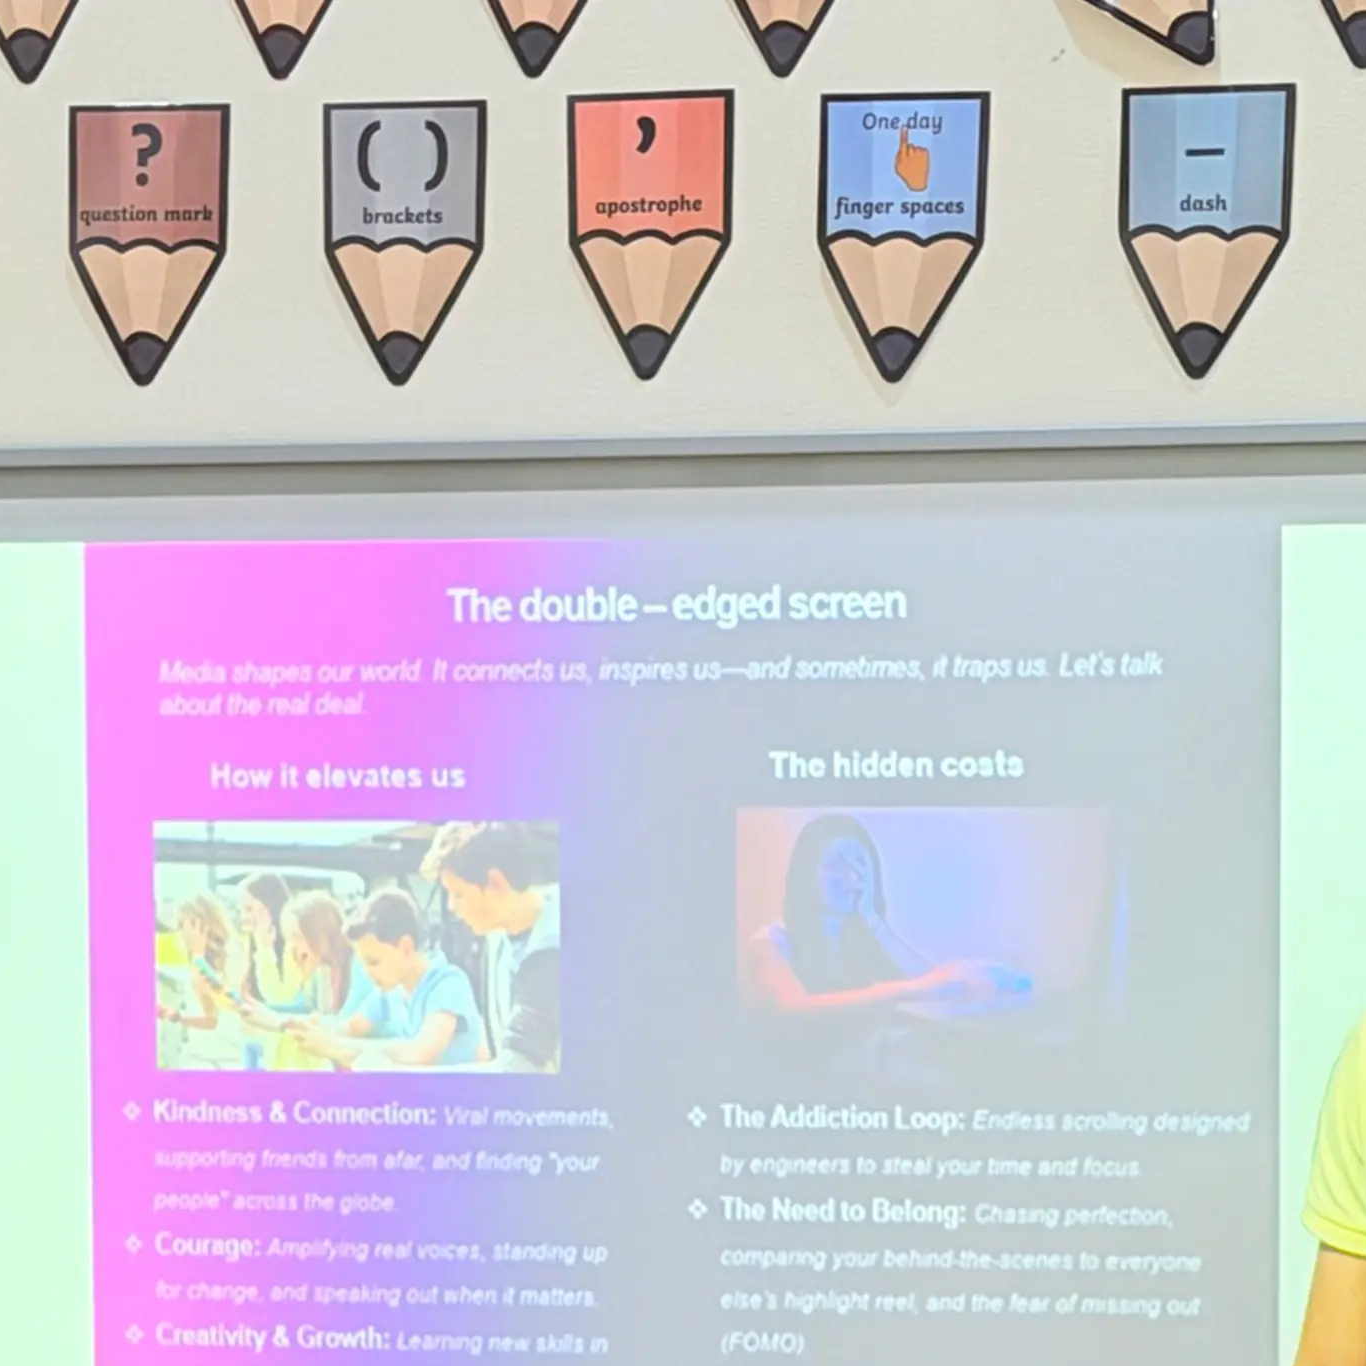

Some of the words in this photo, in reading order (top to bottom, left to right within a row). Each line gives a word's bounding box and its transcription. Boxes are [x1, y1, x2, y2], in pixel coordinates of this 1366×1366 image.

[861, 112, 901, 132] One
[905, 111, 943, 135] day
[131, 122, 164, 187] ?
[79, 204, 158, 226] question
[164, 205, 214, 222] mark
[362, 206, 443, 227] brackets
[594, 194, 703, 219] apostrophe
[834, 196, 893, 219] finger
[899, 198, 965, 219] spaces
[1178, 193, 1228, 214] dash
[446, 587, 512, 622] The
[519, 586, 638, 622] double
[672, 584, 781, 629] edged
[789, 591, 907, 619] screen
[159, 659, 226, 683] Media
[232, 661, 312, 687] shapes
[317, 665, 354, 682] our
[453, 658, 554, 681] connects
[560, 662, 591, 683] us,
[599, 662, 688, 686] inspires
[933, 654, 948, 678] it
[953, 655, 1011, 684] traps
[1121, 651, 1164, 676] talk
[159, 694, 222, 716] about
[227, 693, 262, 716] the
[267, 692, 310, 715] real
[210, 762, 273, 788] How
[281, 763, 298, 787] it
[306, 763, 422, 788] elevates
[432, 768, 465, 788] us
[768, 751, 826, 779] The
[834, 750, 933, 778] hidden
[941, 749, 1024, 777] costs
[153, 1098, 262, 1123] Kindness
[269, 1100, 287, 1123] &
[293, 1101, 436, 1125] Connection:
[445, 1107, 489, 1125] Viral
[494, 1108, 613, 1129] movements,
[720, 1103, 765, 1129] The
[771, 1104, 888, 1129] Addiction
[895, 1105, 965, 1136] Loop:
[973, 1109, 1055, 1130] Endless
[1062, 1111, 1148, 1136] scrolling
[1153, 1112, 1251, 1136] designed
[720, 1196, 765, 1221] The
[773, 1197, 835, 1222] Need
[841, 1201, 866, 1221] to
[872, 1198, 966, 1229] Belong:
[975, 1203, 1060, 1228] Chasing
[1064, 1205, 1173, 1230] perfection,
[155, 1231, 260, 1261] Courage:
[267, 1238, 369, 1262] Amplifying
[374, 1240, 413, 1259] real
[418, 1244, 485, 1262] voices,
[493, 1242, 577, 1265] standing
[583, 1246, 608, 1265] up
[720, 1249, 827, 1271] comparing
[832, 1252, 878, 1271] your
[1080, 1252, 1099, 1270] to
[1105, 1256, 1202, 1275] everyone
[155, 1322, 267, 1353] Creativity
[272, 1324, 290, 1347] &
[297, 1325, 389, 1349] Growth:
[397, 1332, 483, 1355] Learning
[488, 1336, 530, 1352] new
[536, 1334, 584, 1353] skills
[590, 1337, 609, 1353] in
